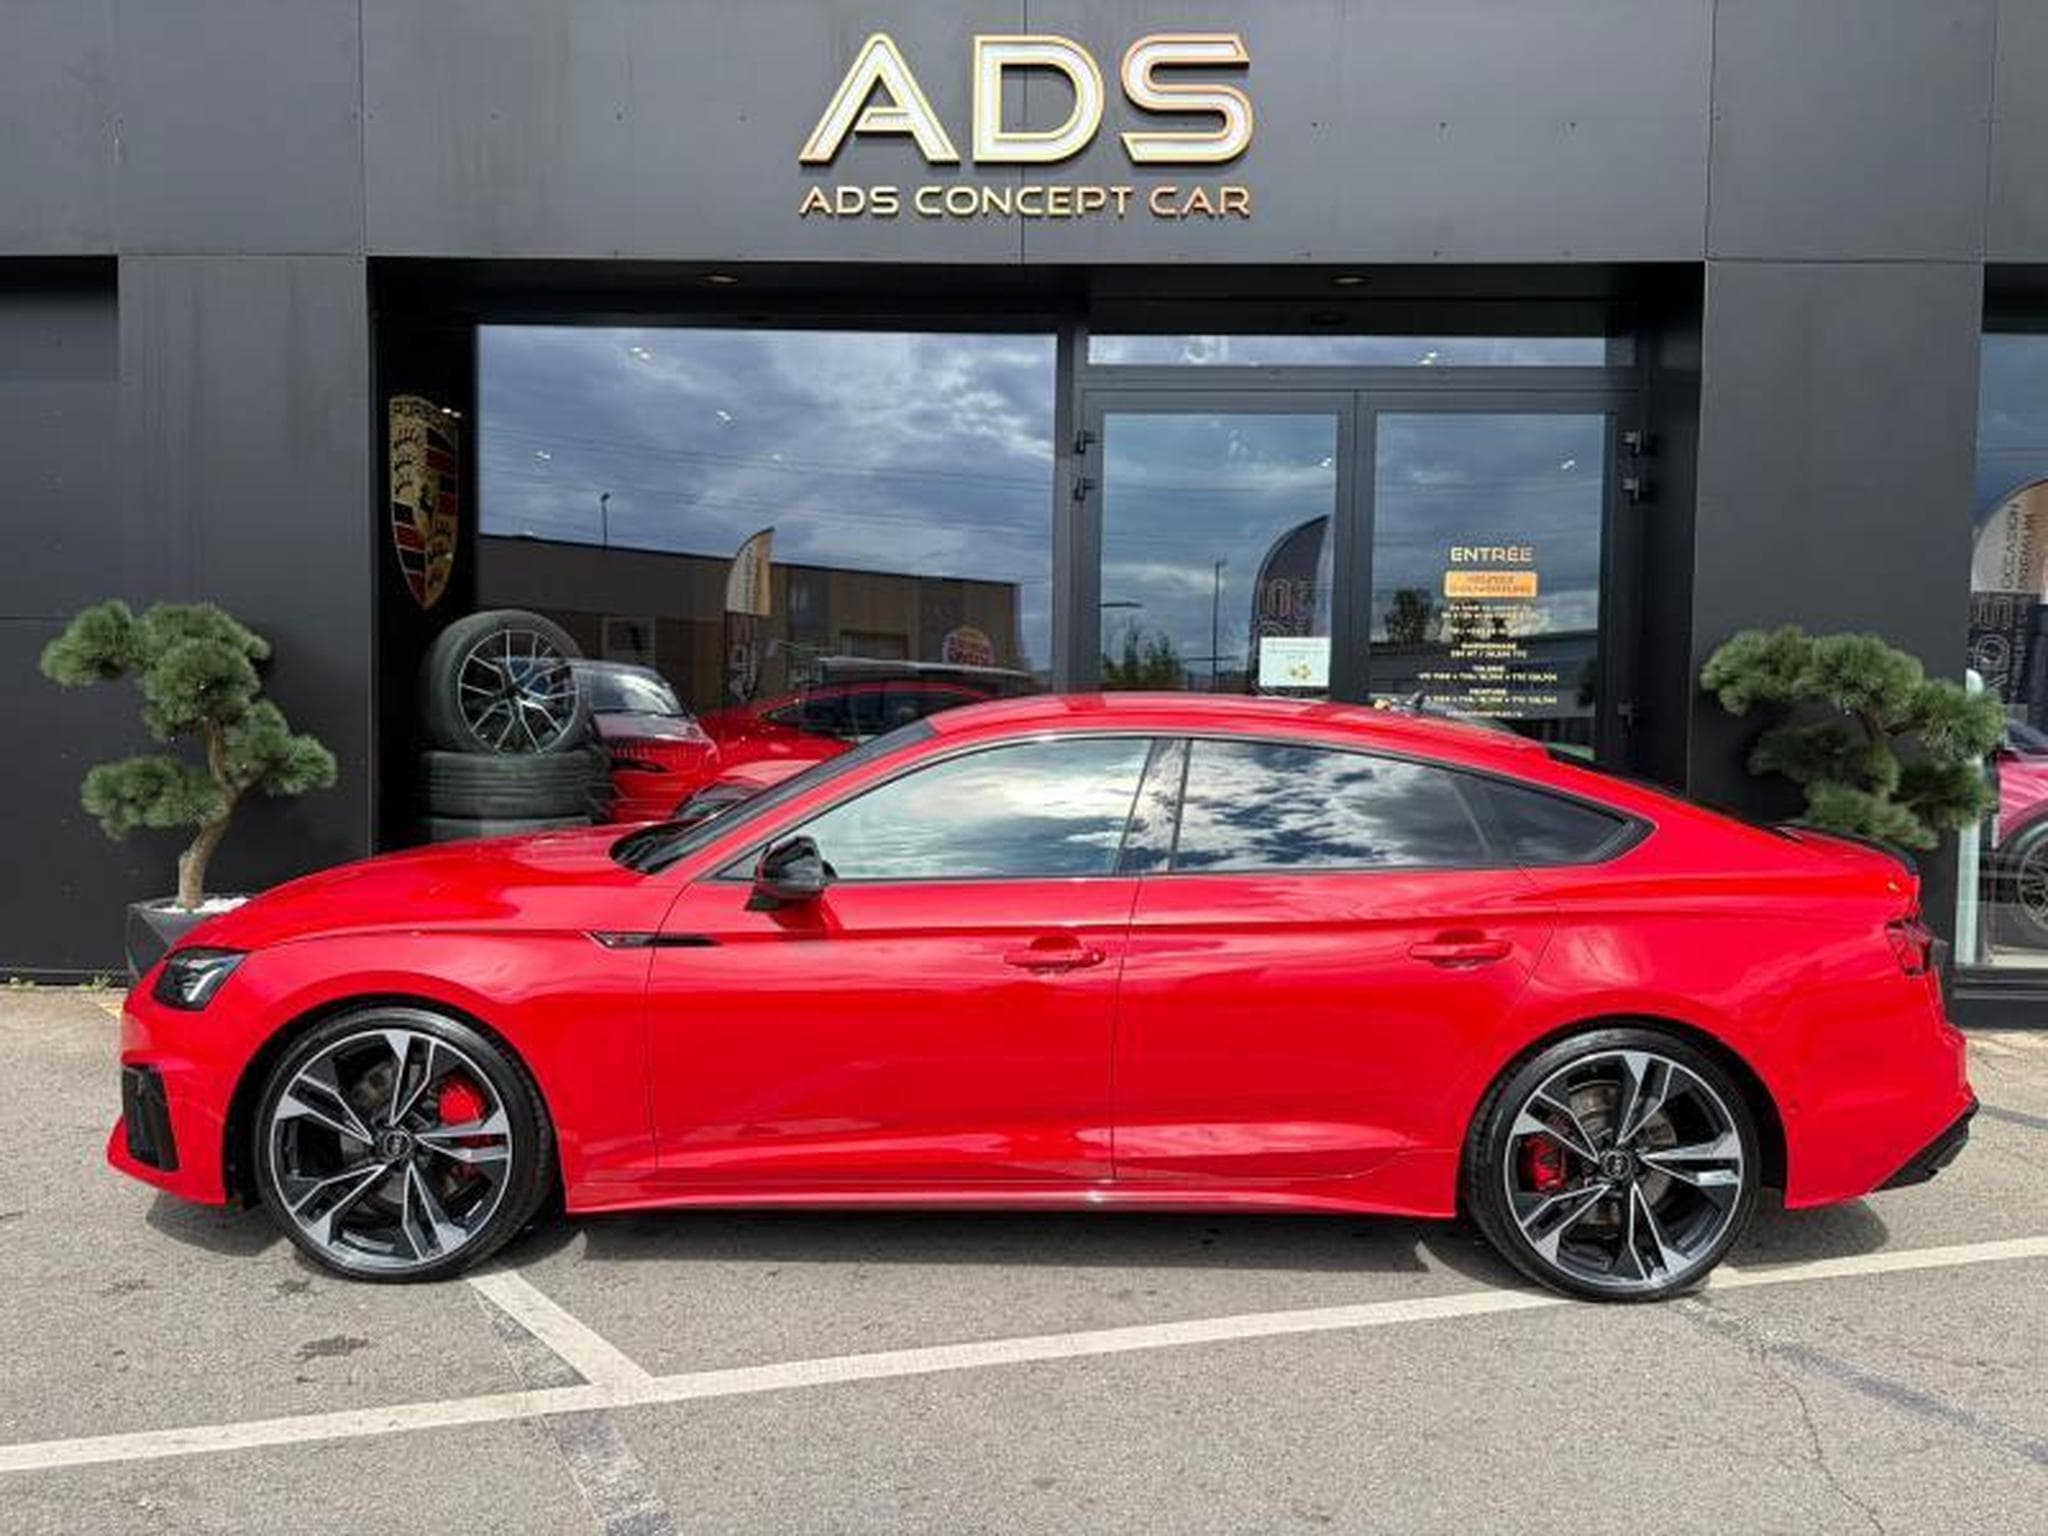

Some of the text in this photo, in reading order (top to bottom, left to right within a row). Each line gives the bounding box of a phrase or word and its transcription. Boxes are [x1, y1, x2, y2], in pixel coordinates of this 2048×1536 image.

[799, 32, 1254, 163] ADS
[799, 186, 1251, 217] ADS CONCEPT CAR
